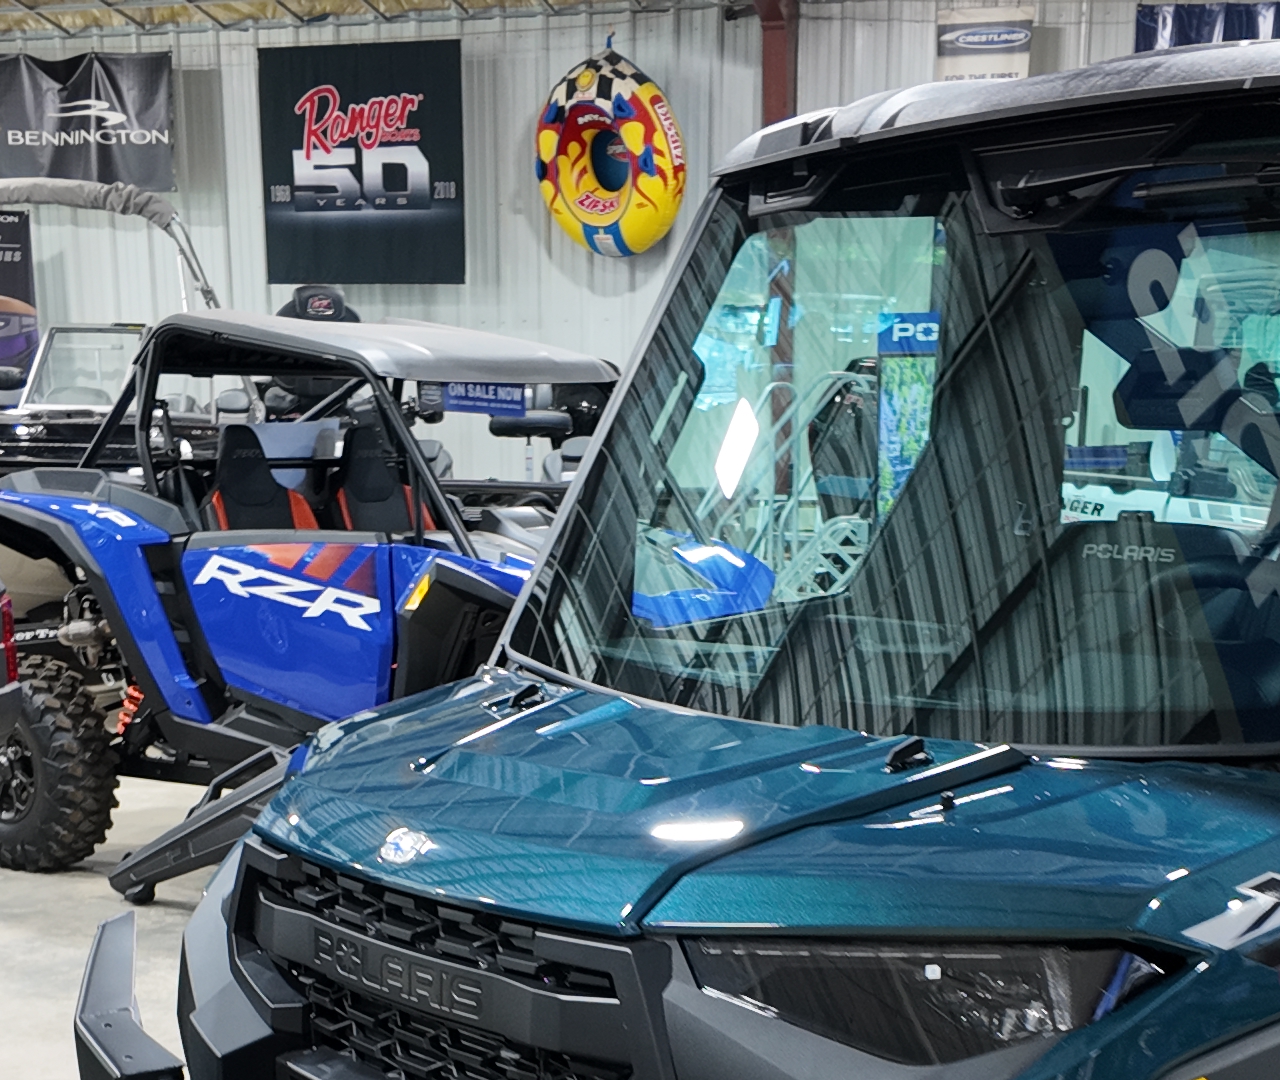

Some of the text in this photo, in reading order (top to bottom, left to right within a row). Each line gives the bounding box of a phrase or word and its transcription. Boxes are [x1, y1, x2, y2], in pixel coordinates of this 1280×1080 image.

[7, 129, 169, 147] BENNINGTON
[294, 84, 419, 161] Ranger
[292, 145, 432, 212] 50
[316, 197, 408, 207] YEARS
[447, 382, 466, 397] ON
[466, 383, 497, 400] SALE
[496, 386, 523, 402] NOW
[1082, 543, 1176, 563] POLARIS
[193, 554, 381, 632] RZR
[313, 927, 483, 1021] POLARIS
